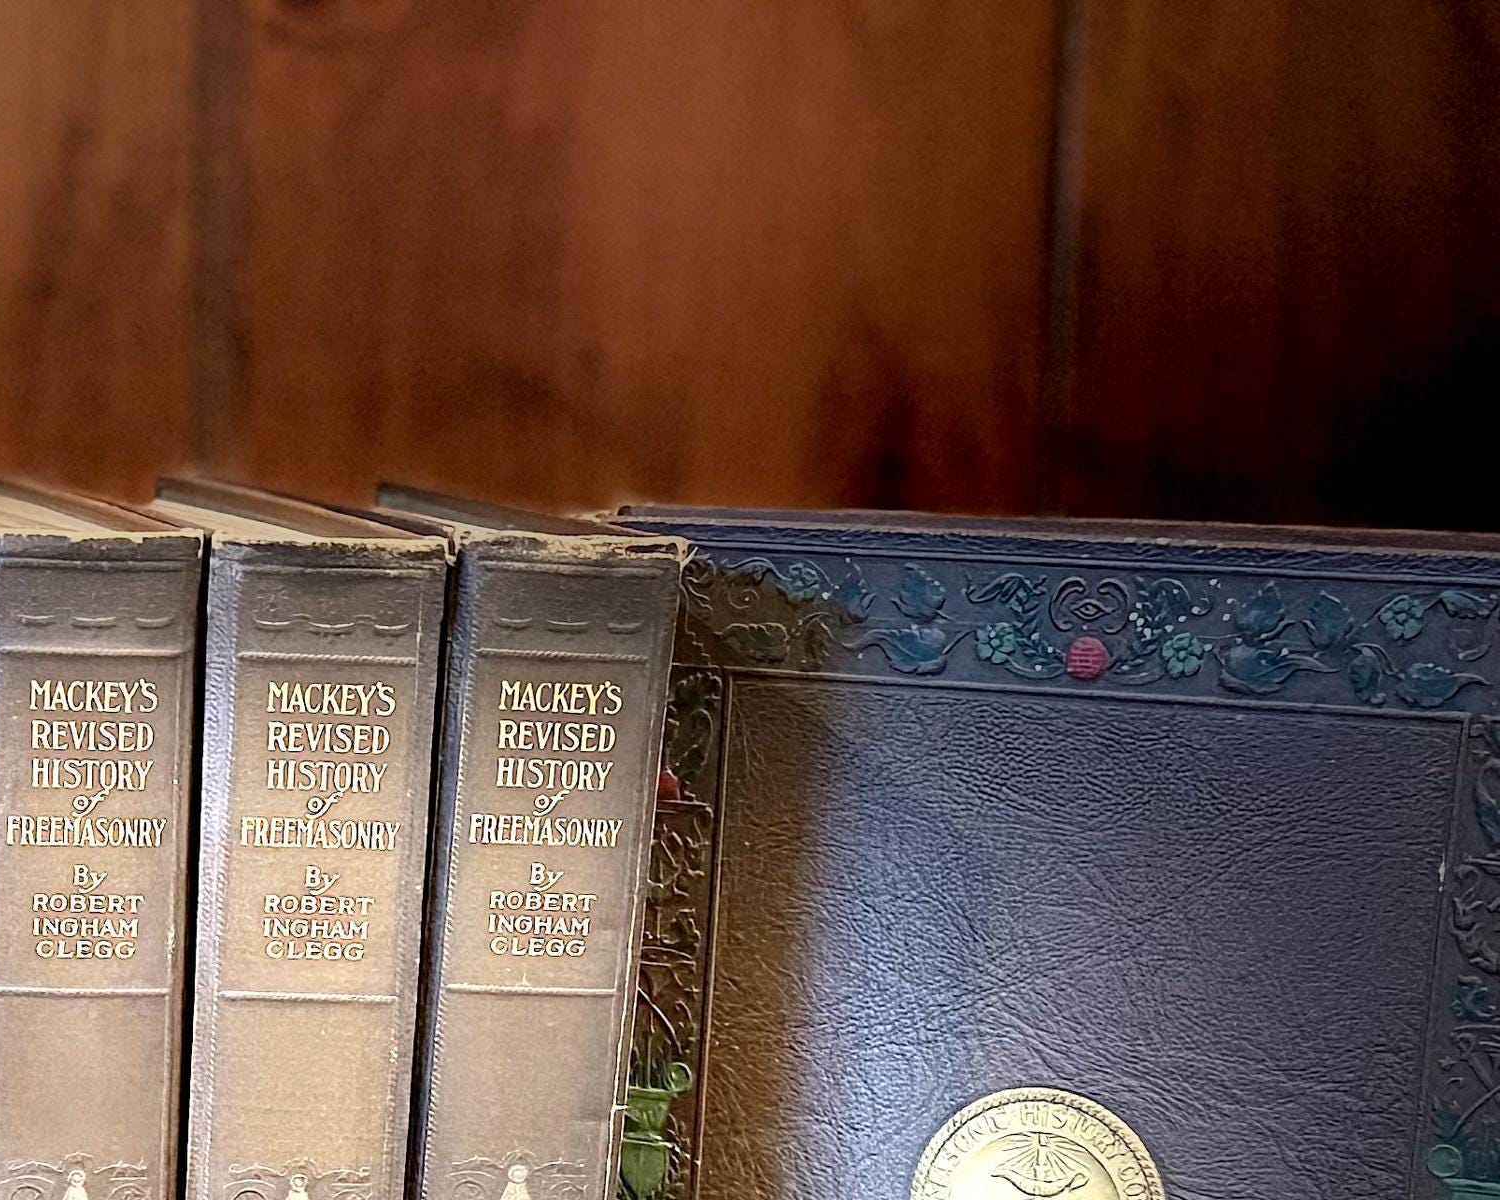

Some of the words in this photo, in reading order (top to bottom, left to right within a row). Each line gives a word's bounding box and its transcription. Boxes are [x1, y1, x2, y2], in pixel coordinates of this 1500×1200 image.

[29, 678, 158, 713] MACKEY'S
[266, 681, 396, 717] MACKEY'S
[498, 680, 623, 716] MACKEY'S
[31, 720, 154, 751] REVISED
[267, 721, 390, 754] REVISED
[498, 719, 617, 752] REVISED
[32, 759, 154, 791] HISTORY
[266, 759, 388, 793] HISTORY
[496, 757, 614, 791] HISTORY
[71, 788, 109, 818] of
[304, 789, 345, 820] of
[534, 788, 571, 817] of
[6, 815, 167, 847] FREEMASONRY
[239, 815, 401, 851] FREEMASONRY
[468, 813, 623, 848] FREEMASONRY
[73, 863, 108, 894] By
[304, 864, 340, 896] By
[529, 862, 564, 892] By
[32, 893, 146, 913] ROBERT
[264, 894, 375, 916] ROBERT
[489, 891, 597, 912] ROBERT
[32, 917, 139, 937] INGHAM
[263, 918, 369, 940] INGHAM
[488, 914, 591, 936] INGHAM
[35, 939, 137, 959] CLEGG
[265, 939, 365, 961] CLEGG
[490, 936, 586, 957] CLEGG
[1019, 1103, 1126, 1160] HISTORY
